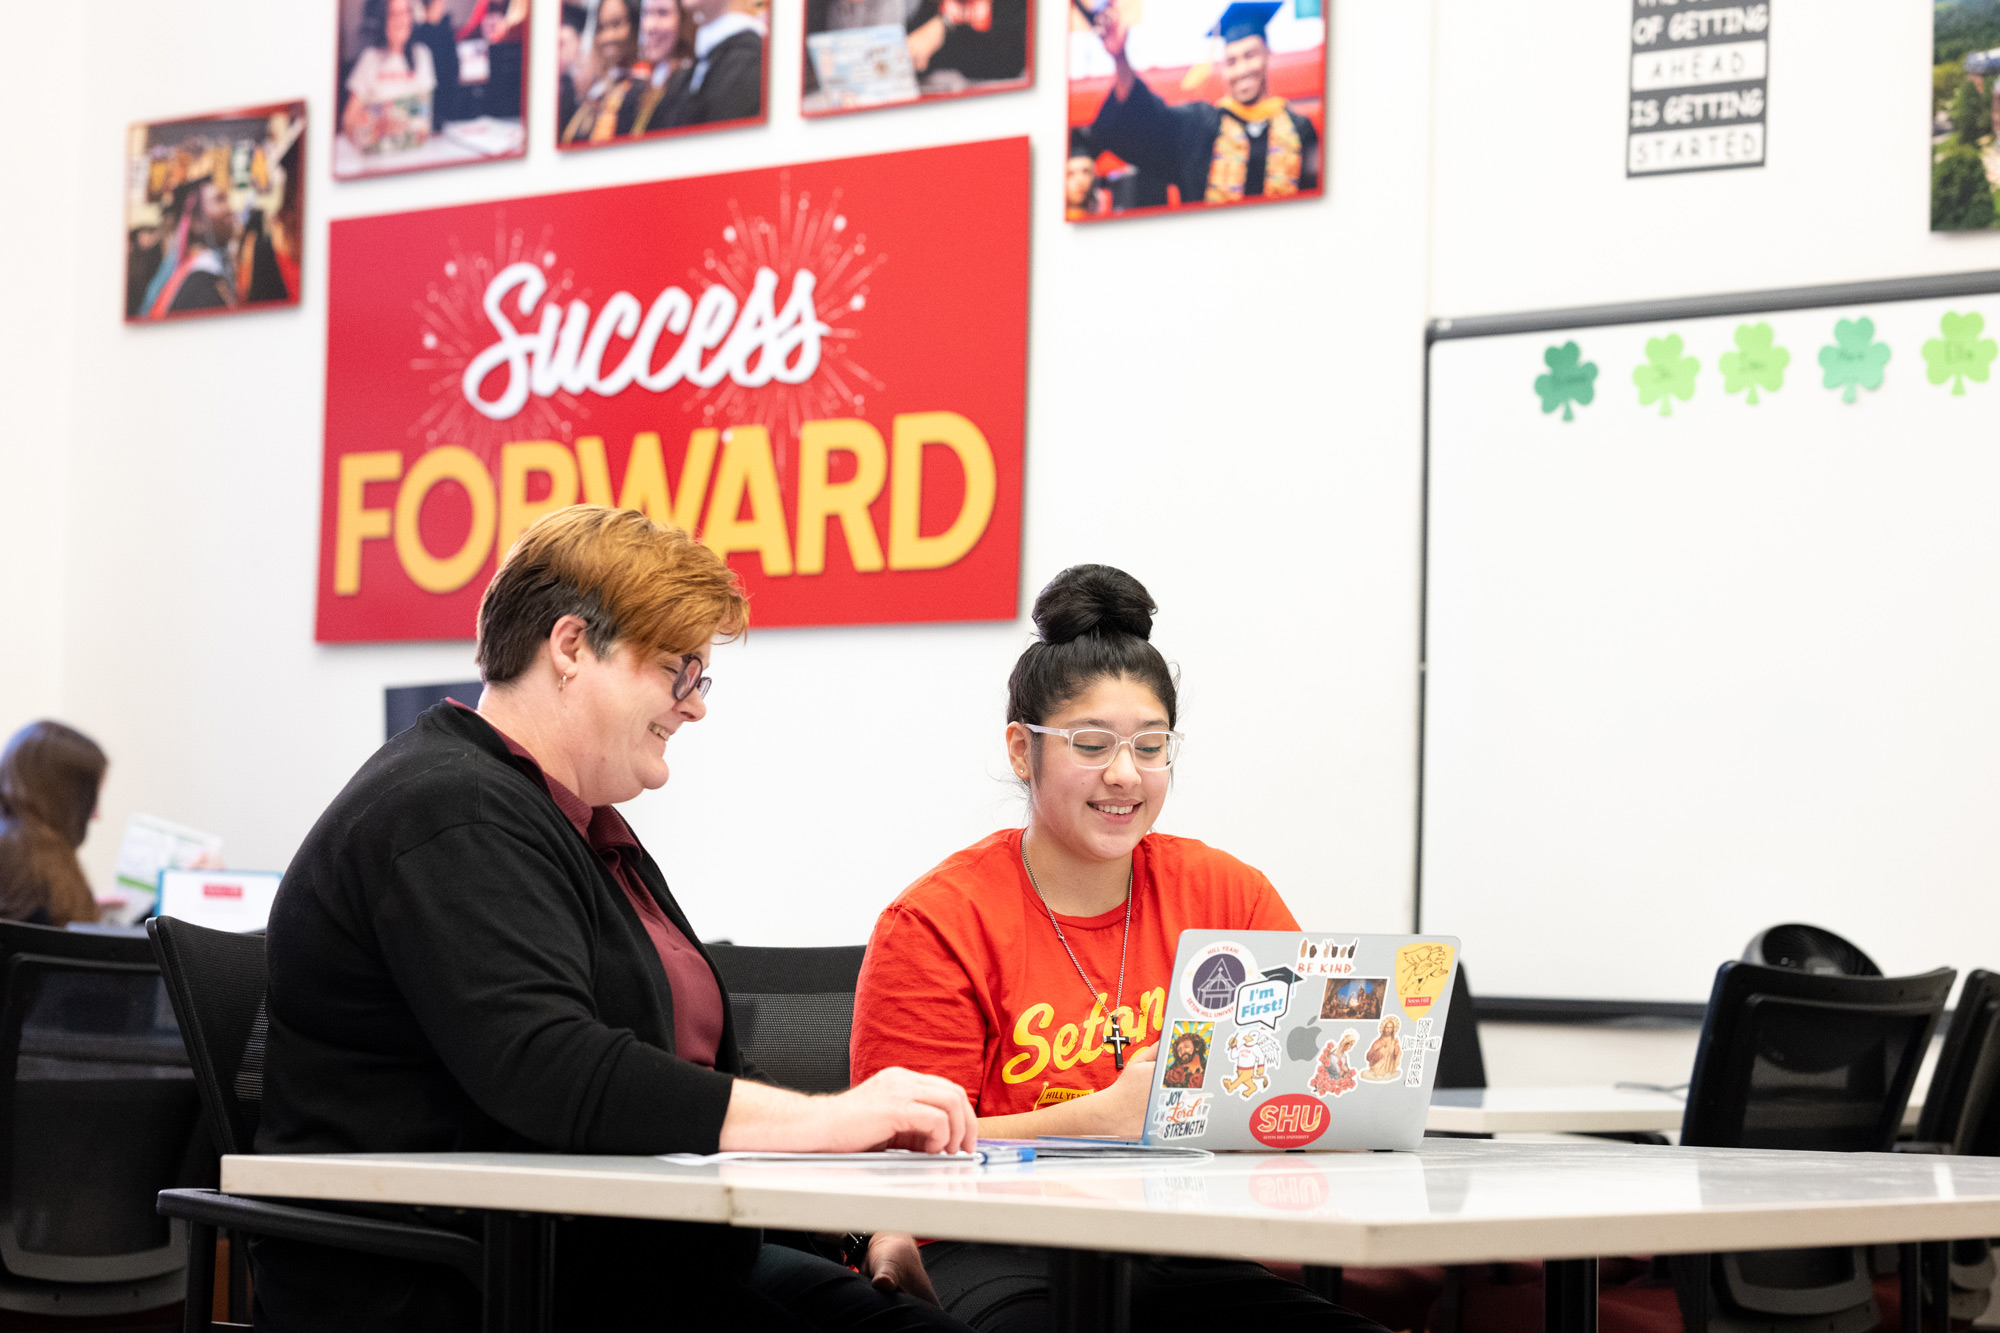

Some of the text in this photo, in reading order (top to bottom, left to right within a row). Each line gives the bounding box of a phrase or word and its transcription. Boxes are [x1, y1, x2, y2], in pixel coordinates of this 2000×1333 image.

[1633, 4, 1769, 45] OF GETTING
[1653, 51, 1745, 78] AHEAD
[1630, 88, 1765, 128] IS GETTING
[1637, 131, 1756, 164] STARTED
[461, 262, 833, 419] Success
[1207, 946, 1220, 955] HILL
[1298, 963, 1352, 974] BE KIND
[1249, 988, 1274, 1001] I'm
[1241, 998, 1283, 1018] First!
[1001, 986, 1166, 1084] Seton
[1046, 1091, 1064, 1100] HILL
[1165, 1090, 1184, 1107] JOY
[1166, 1097, 1203, 1123] Lord
[1257, 1105, 1323, 1133] SHU
[1164, 1119, 1206, 1139] STRENGTH
